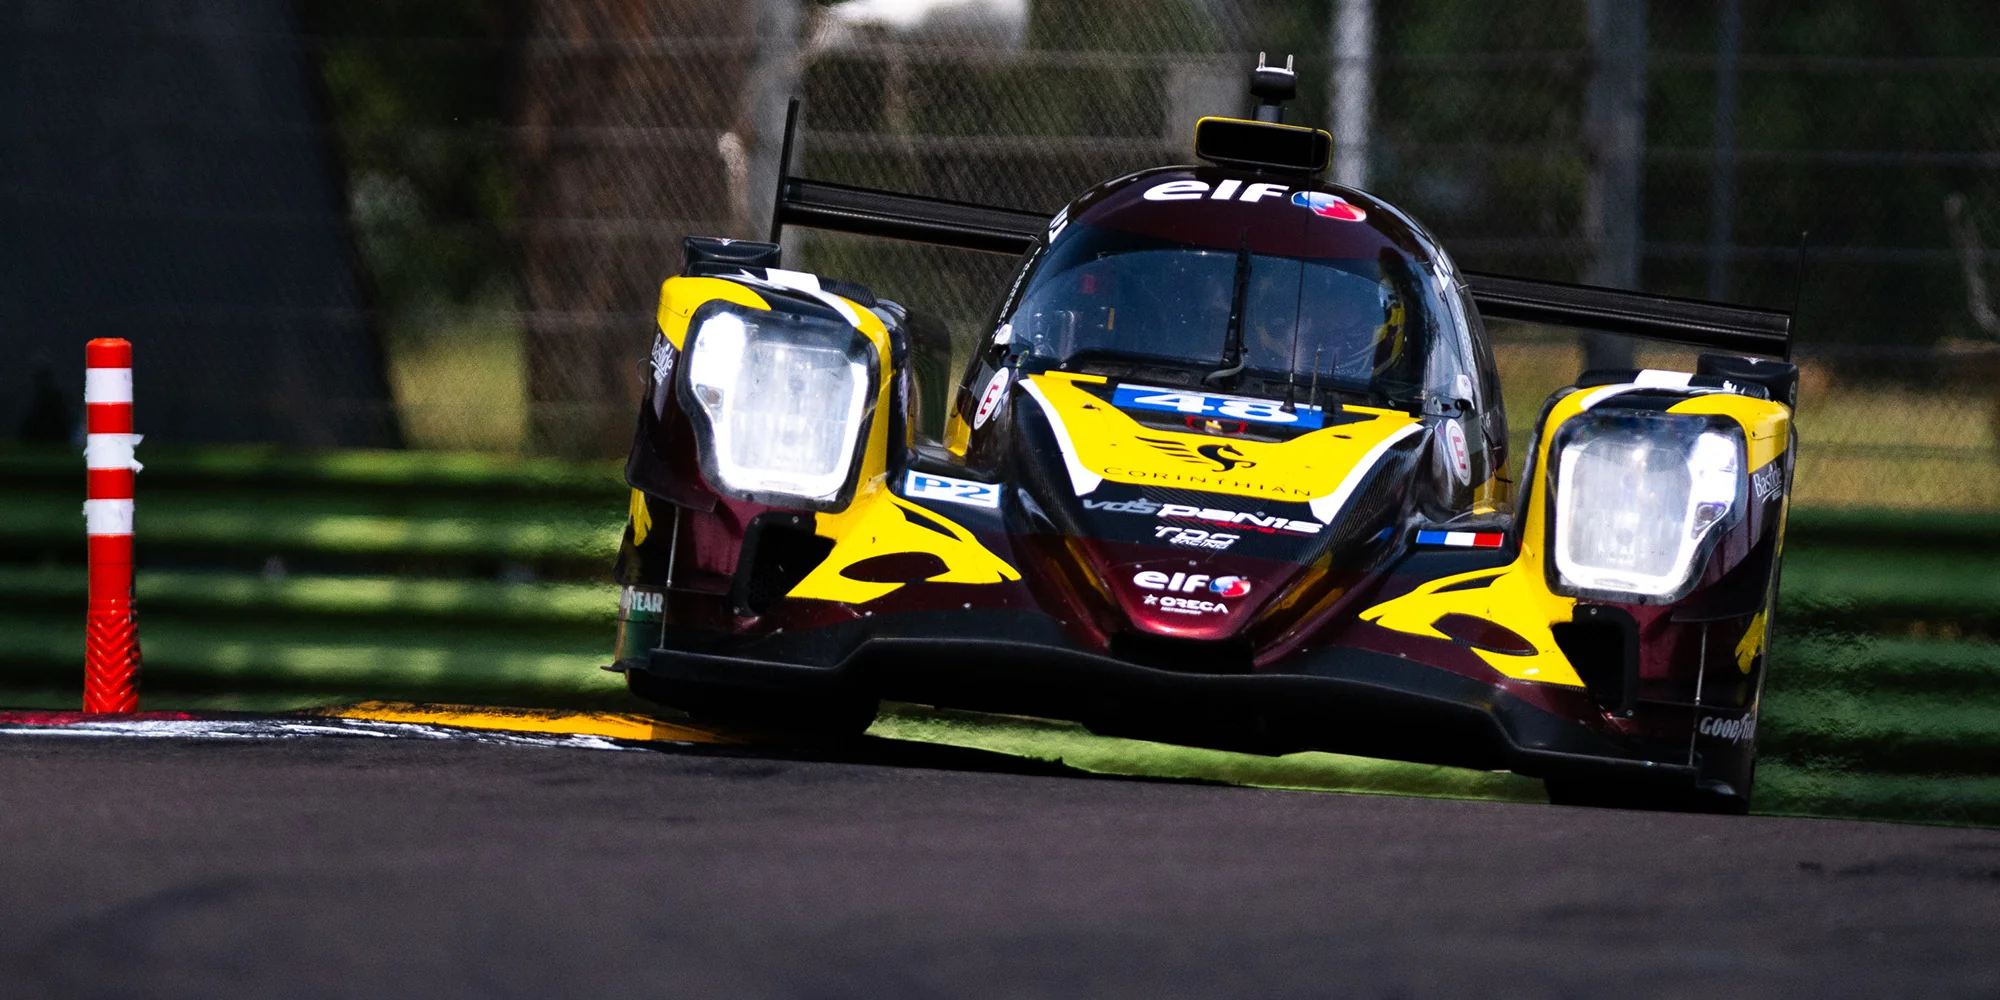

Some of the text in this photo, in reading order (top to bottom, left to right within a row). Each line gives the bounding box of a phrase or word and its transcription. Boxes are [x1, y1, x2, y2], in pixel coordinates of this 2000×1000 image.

[1143, 179, 1290, 202] elf
[980, 384, 999, 415] E
[1134, 393, 1298, 423] 48
[1452, 436, 1466, 470] E
[914, 476, 991, 502] P2
[1104, 467, 1310, 496] CORINTHIAN
[1133, 570, 1210, 593] elf
[1160, 596, 1229, 615] ORECA
